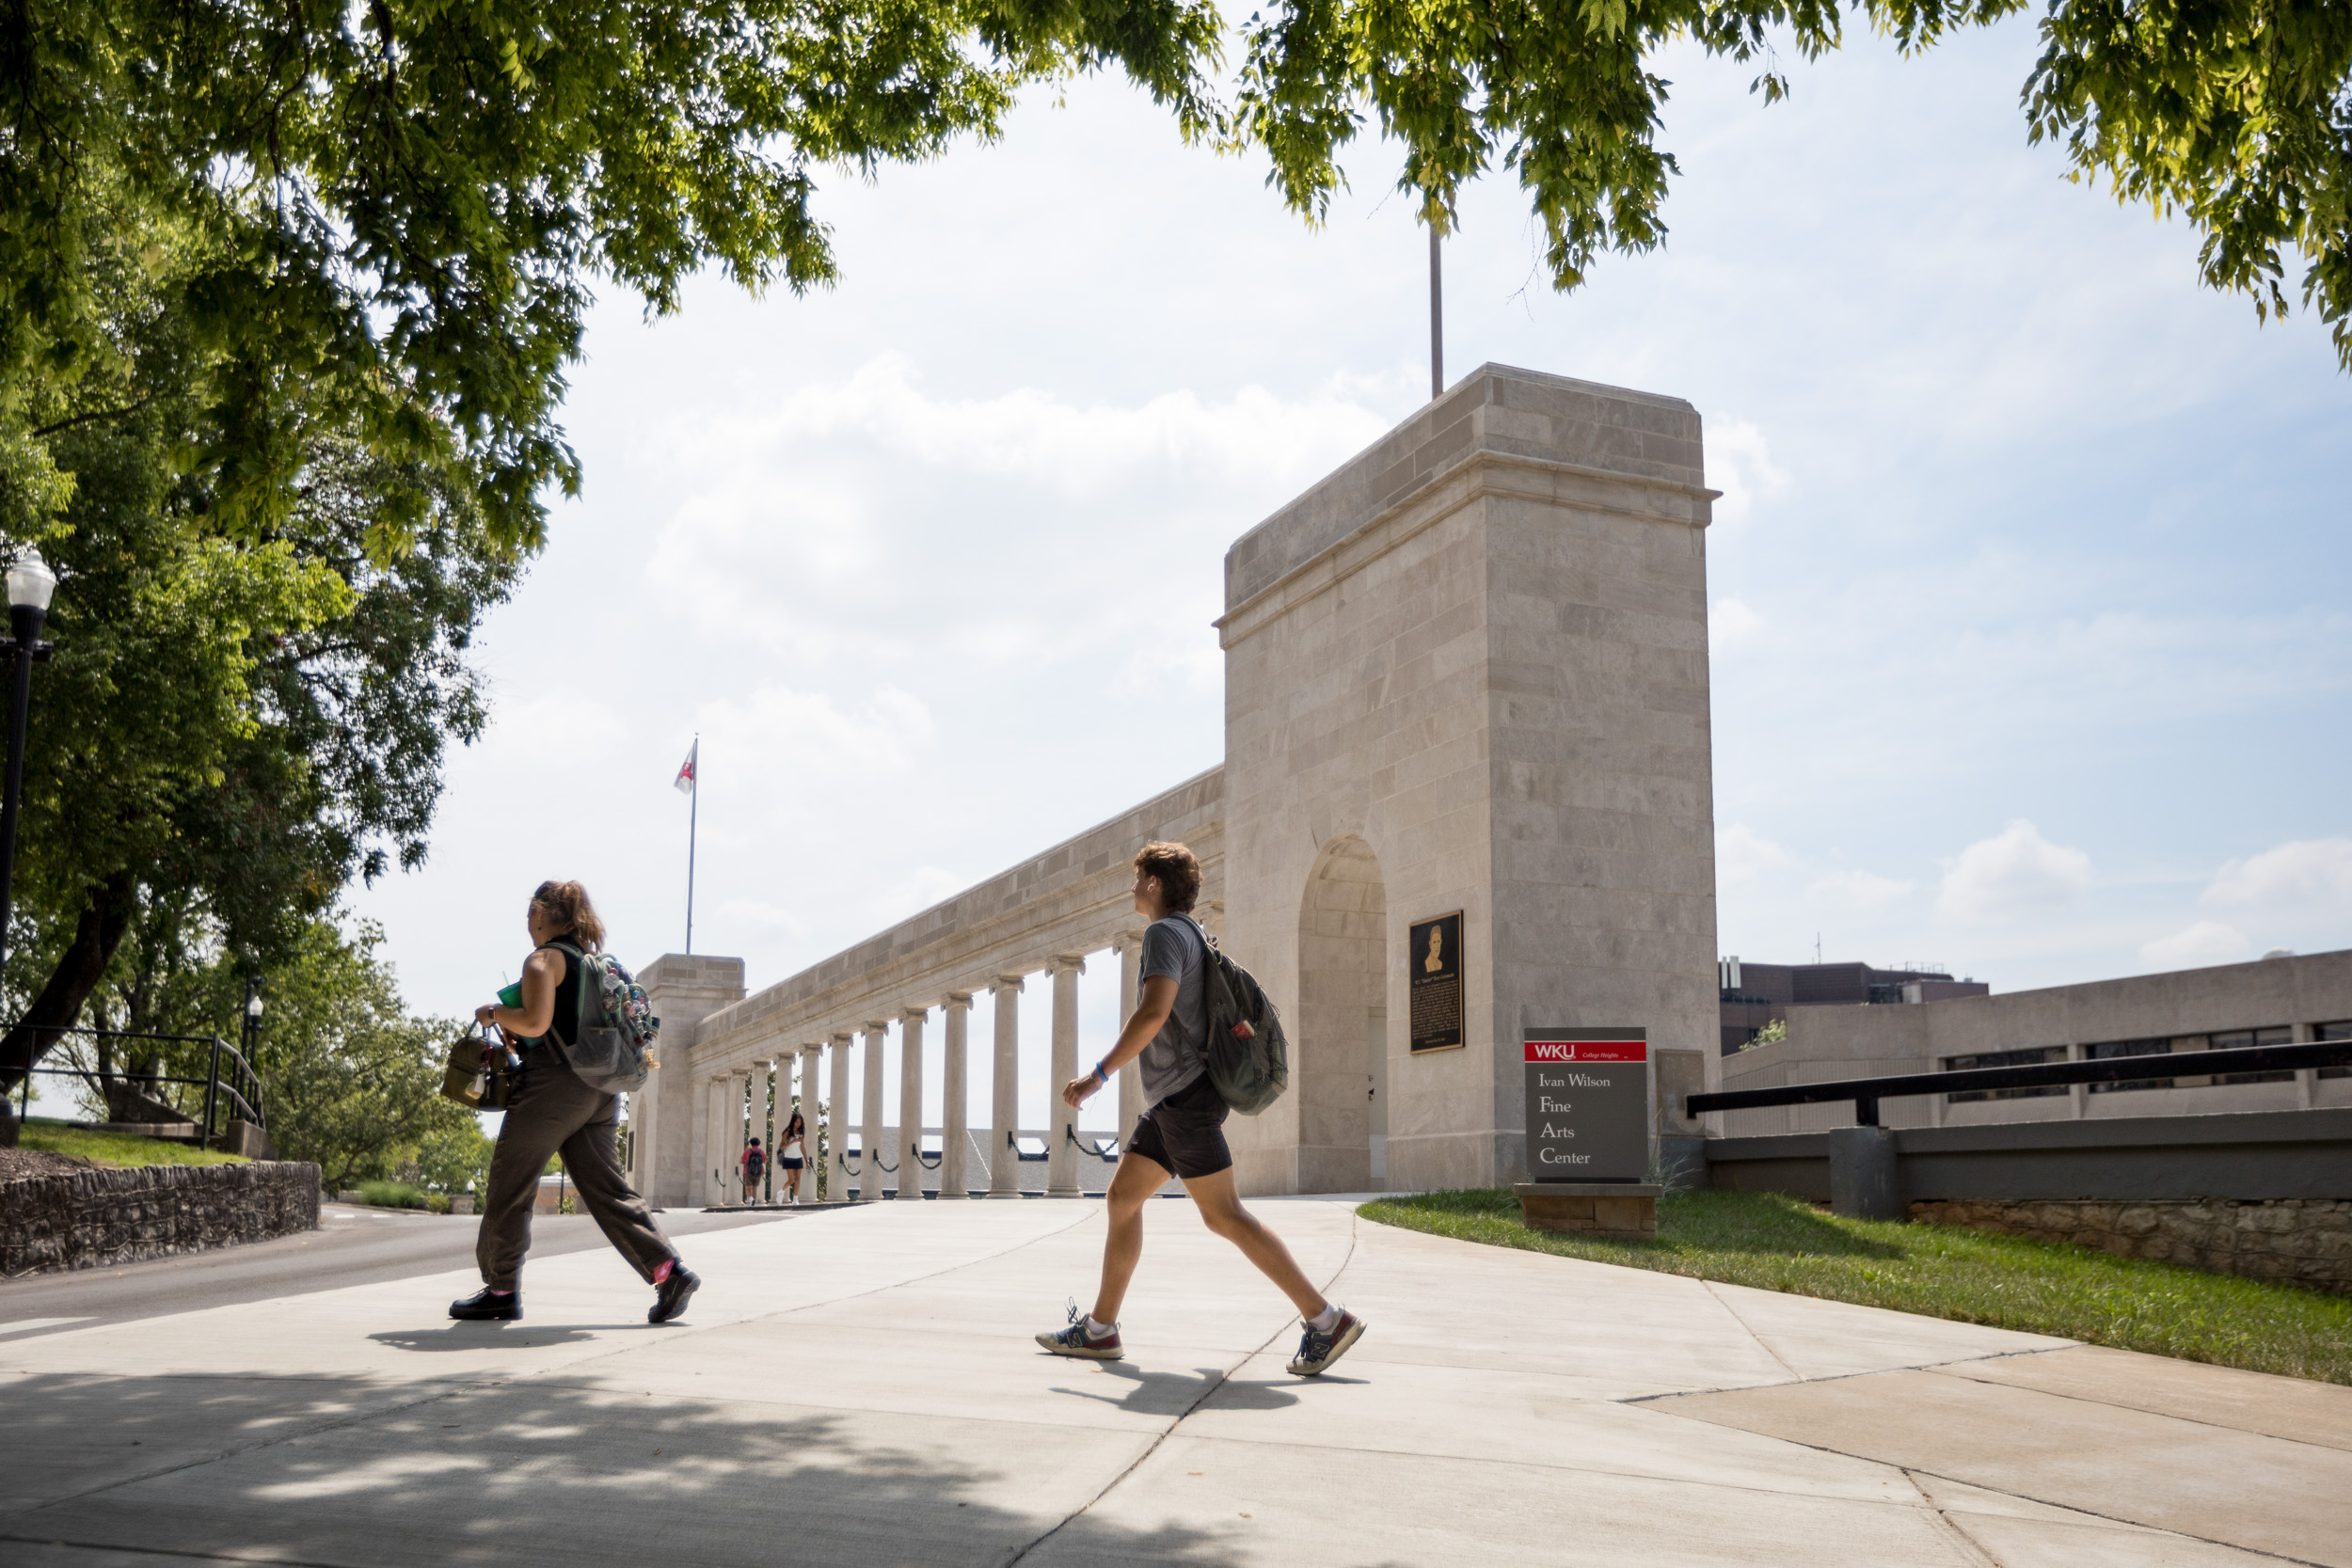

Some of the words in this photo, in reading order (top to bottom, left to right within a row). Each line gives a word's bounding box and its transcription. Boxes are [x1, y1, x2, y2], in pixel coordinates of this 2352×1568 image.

[1534, 1045, 1575, 1060] WKU
[1539, 1073, 1565, 1087] Ivan
[1567, 1073, 1611, 1087] Wilson
[1539, 1096, 1571, 1113] Fine
[1540, 1122, 1575, 1137] Arts
[1539, 1148, 1590, 1164] Center
[1066, 1333, 1082, 1347] N
